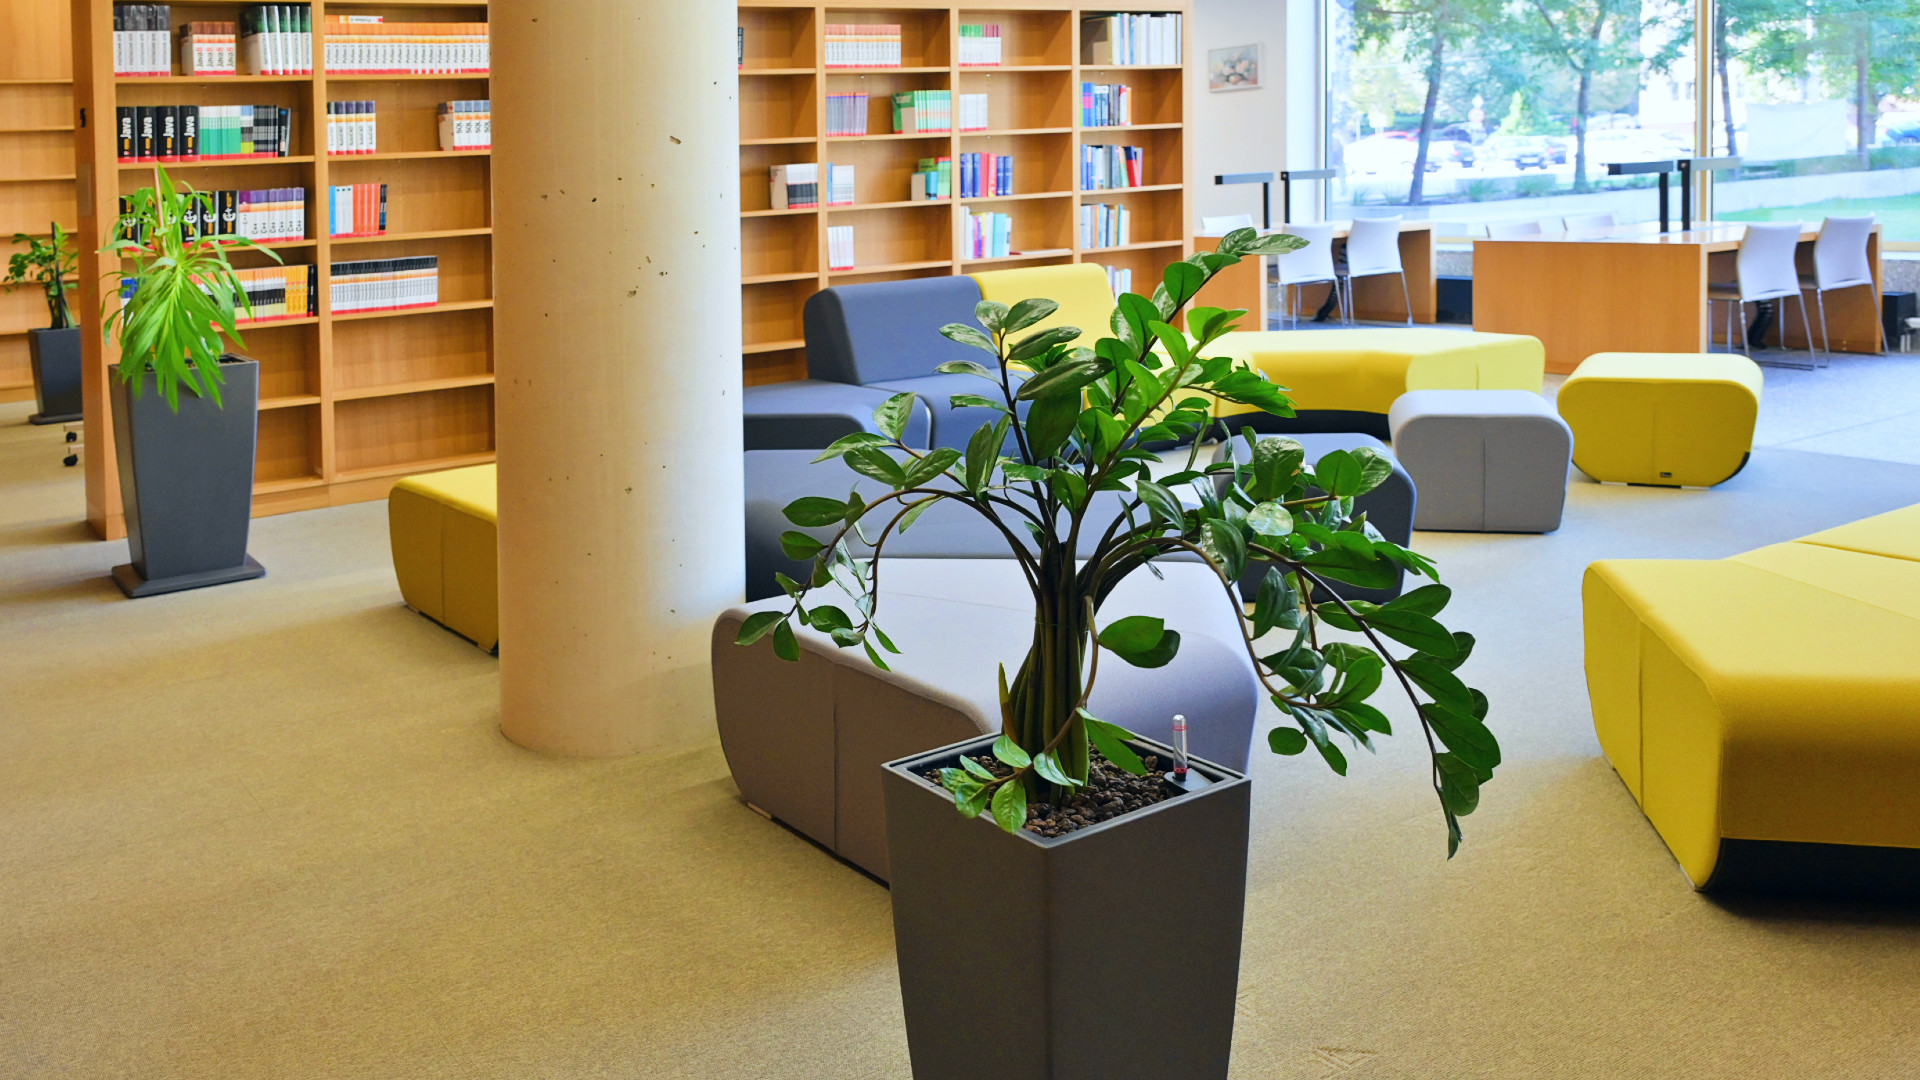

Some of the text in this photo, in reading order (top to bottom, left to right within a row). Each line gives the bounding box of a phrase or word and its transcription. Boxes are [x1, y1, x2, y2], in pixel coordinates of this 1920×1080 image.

[195, 52, 203, 67] Java
[216, 52, 224, 67] Java
[226, 52, 234, 67] Java
[120, 117, 132, 139] Java
[141, 116, 153, 139] Java
[163, 116, 174, 138] Java
[184, 115, 195, 138] Java
